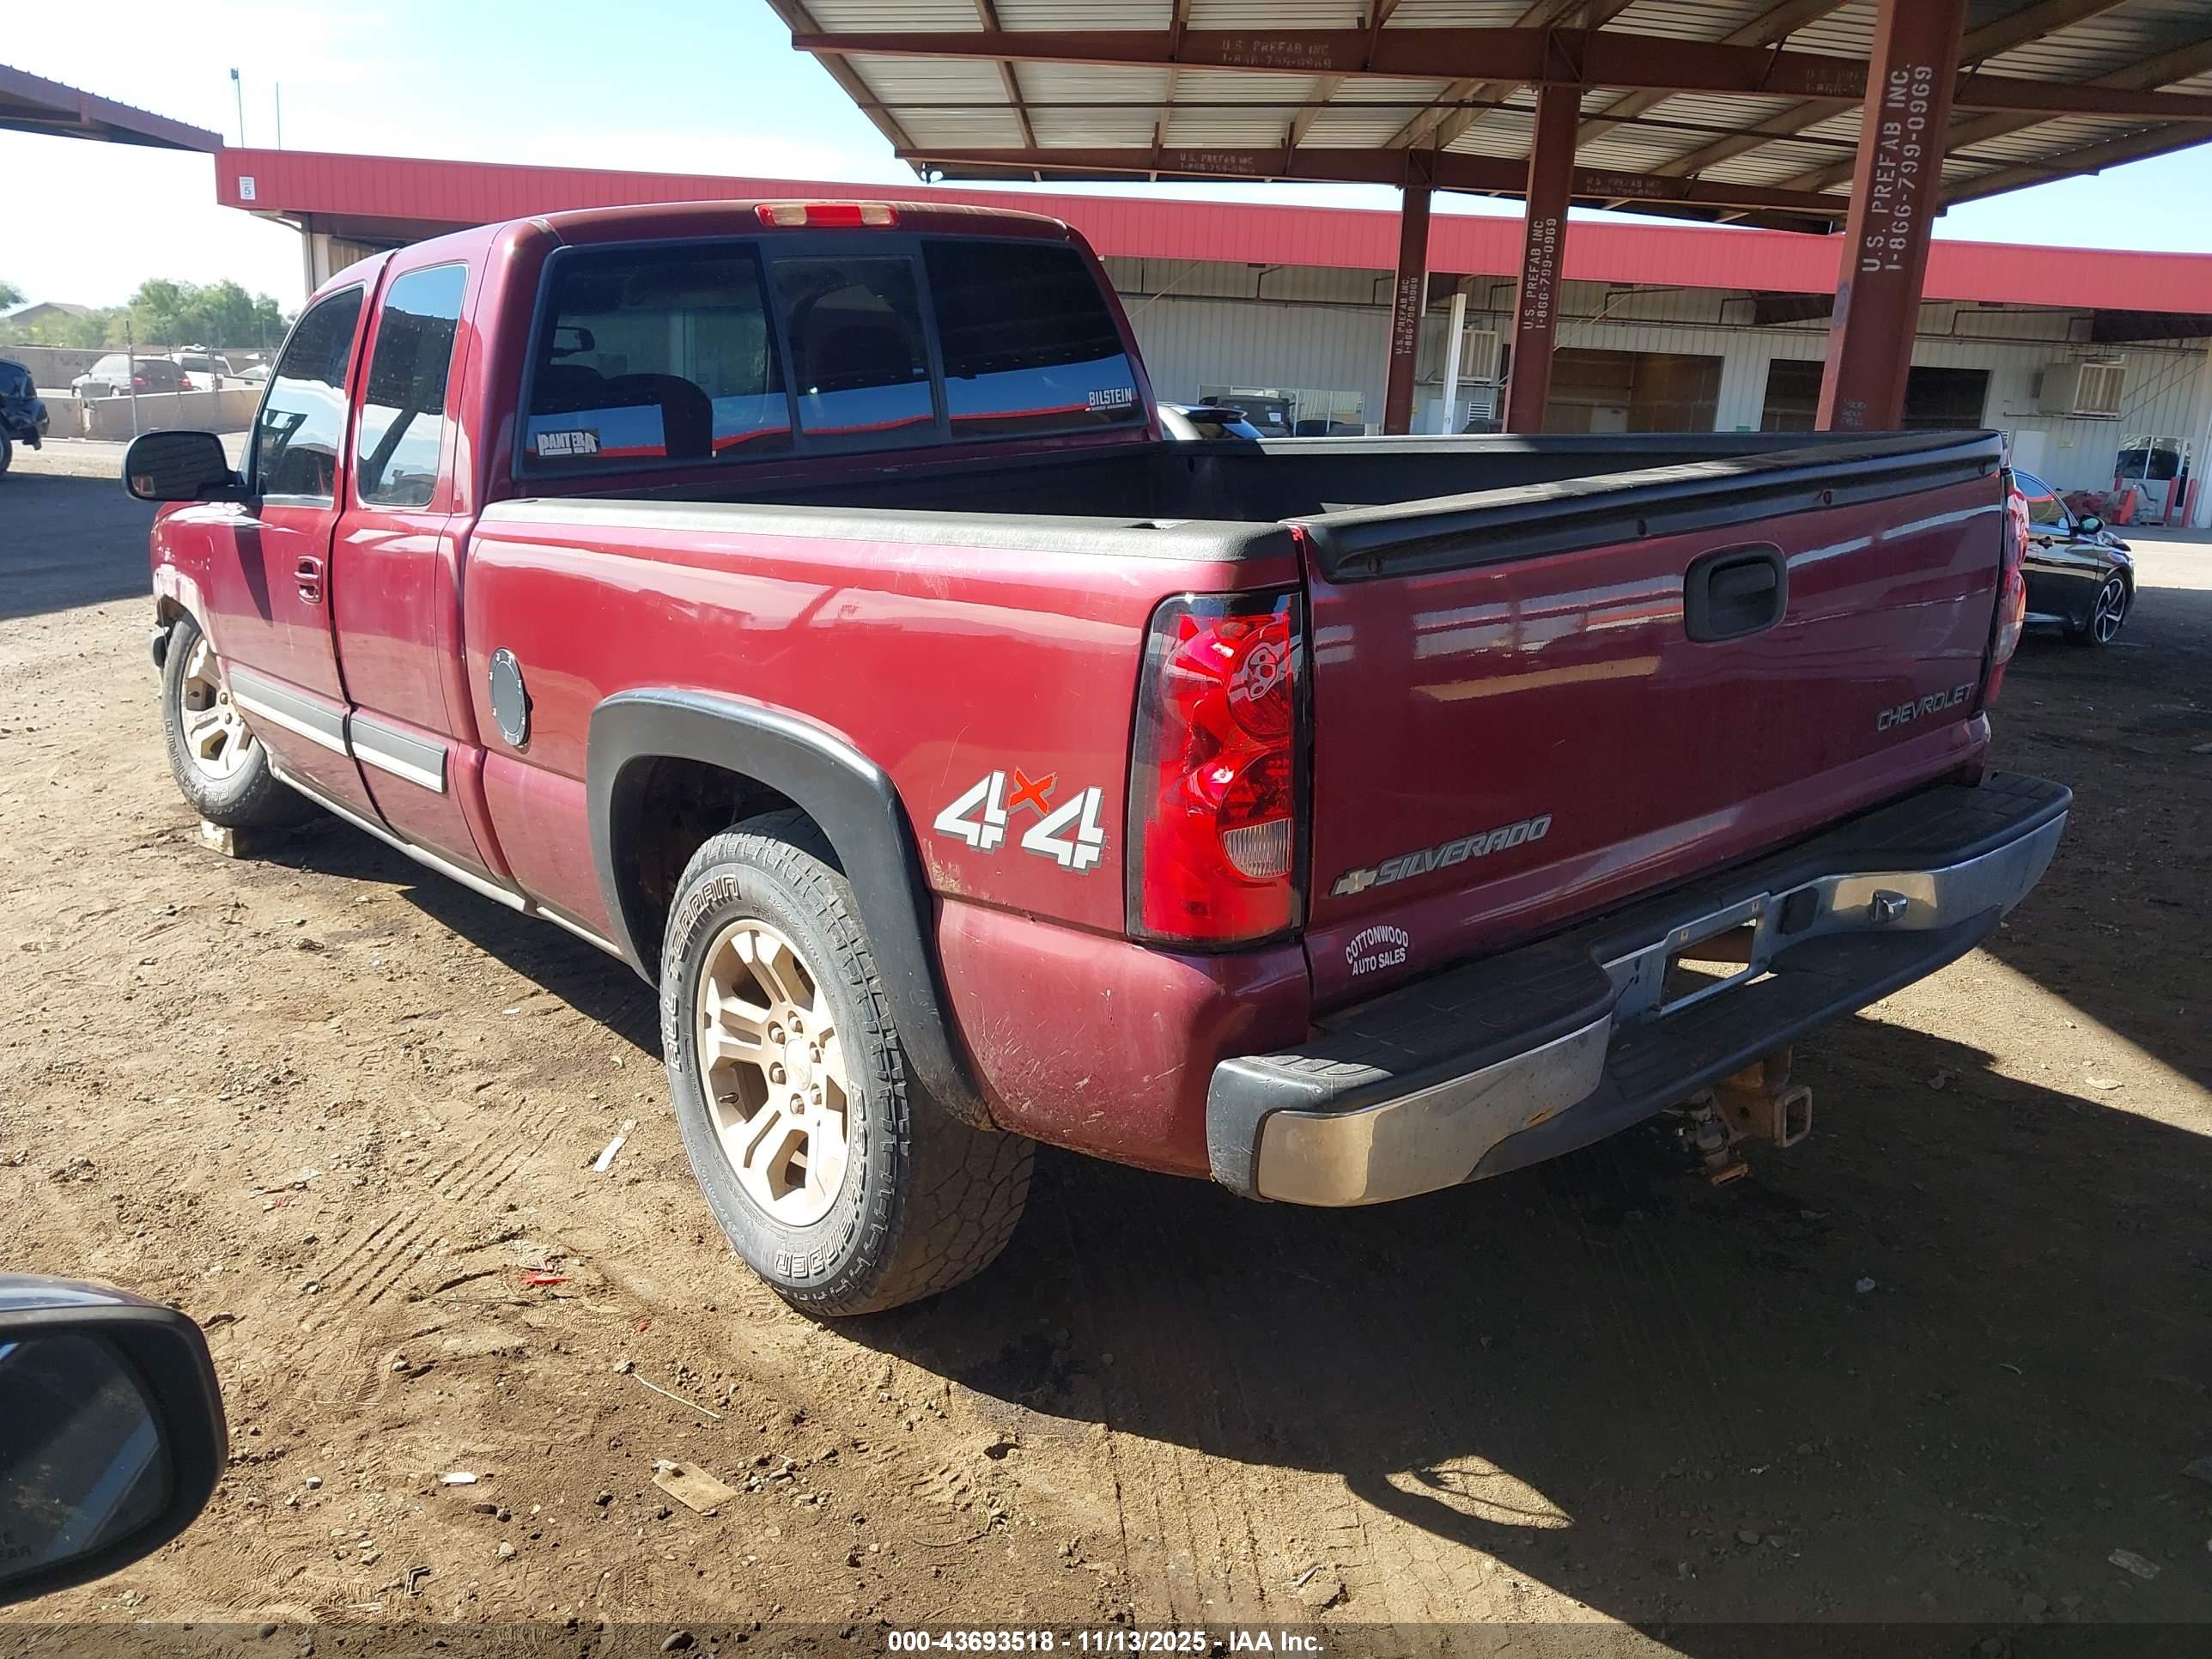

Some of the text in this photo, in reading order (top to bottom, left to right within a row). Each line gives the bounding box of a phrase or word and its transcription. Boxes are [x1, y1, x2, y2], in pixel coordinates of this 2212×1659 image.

[244, 186, 252, 195] 5
[1862, 64, 1911, 272] U.S. PREFAB INC.
[1885, 66, 1932, 270] 1-866-799-0969
[1526, 247, 1541, 298] PREFAB
[1535, 217, 1557, 329] 1-866-799-0969
[1397, 298, 1408, 333] PREFAB
[1089, 387, 1133, 406] BILSTEIN
[537, 432, 599, 456] PANTERA
[1877, 683, 1974, 731] CHEVROLET
[1376, 815, 1553, 887] SILVERADO
[667, 874, 743, 982] TERRAIN
[1346, 925, 1409, 964] COTTONWOOD
[1352, 947, 1406, 976] AUTO SALES
